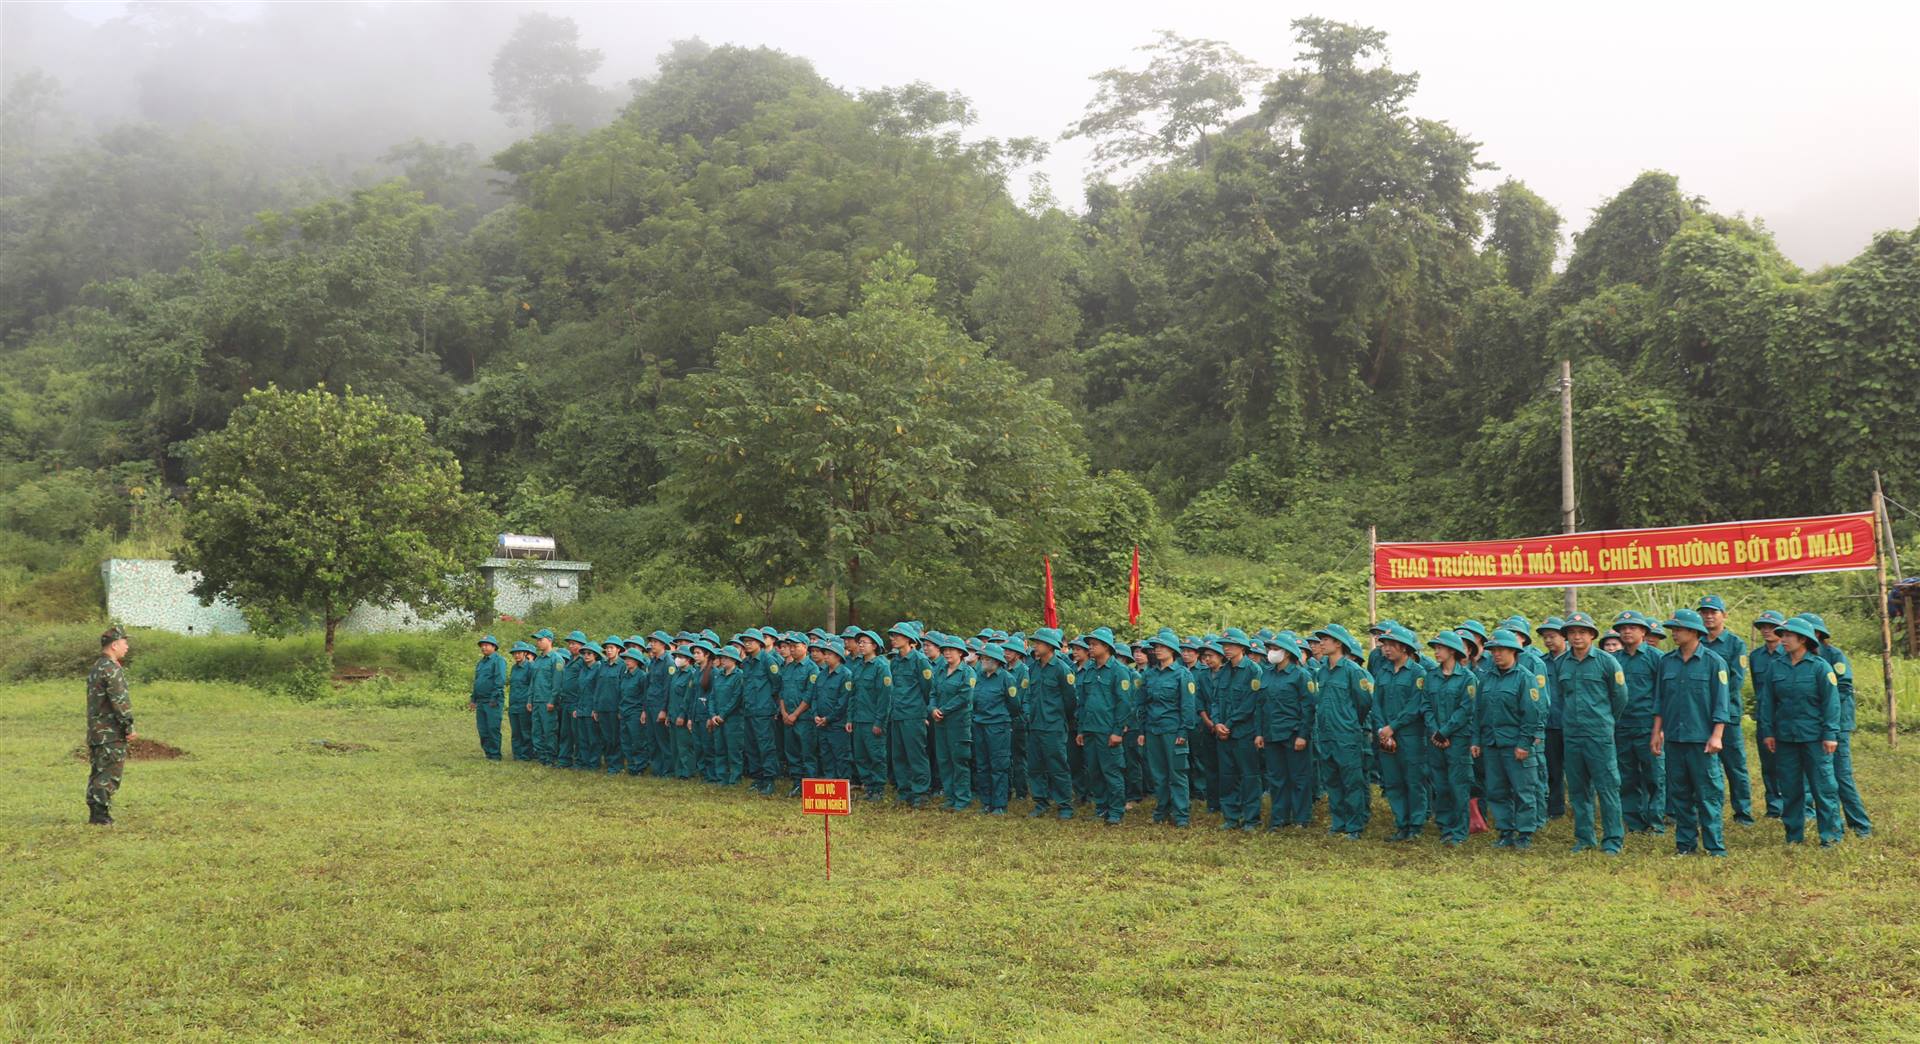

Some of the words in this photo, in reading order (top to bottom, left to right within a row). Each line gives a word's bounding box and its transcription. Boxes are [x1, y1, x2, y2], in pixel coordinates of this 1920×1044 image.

[1388, 557, 1429, 579] THAO
[1432, 550, 1497, 577] TRƯỜNG
[1500, 545, 1524, 576] ĐỔ
[1528, 545, 1556, 575] MỒ
[1559, 546, 1595, 575] HÔI,
[1599, 539, 1653, 572] CHIẾN
[1656, 537, 1731, 568] TRƯỜNG
[1734, 534, 1770, 563] BỚT
[1775, 527, 1803, 561] ĐỔ
[1806, 528, 1854, 558] MÁU
[815, 783, 825, 795] KHU
